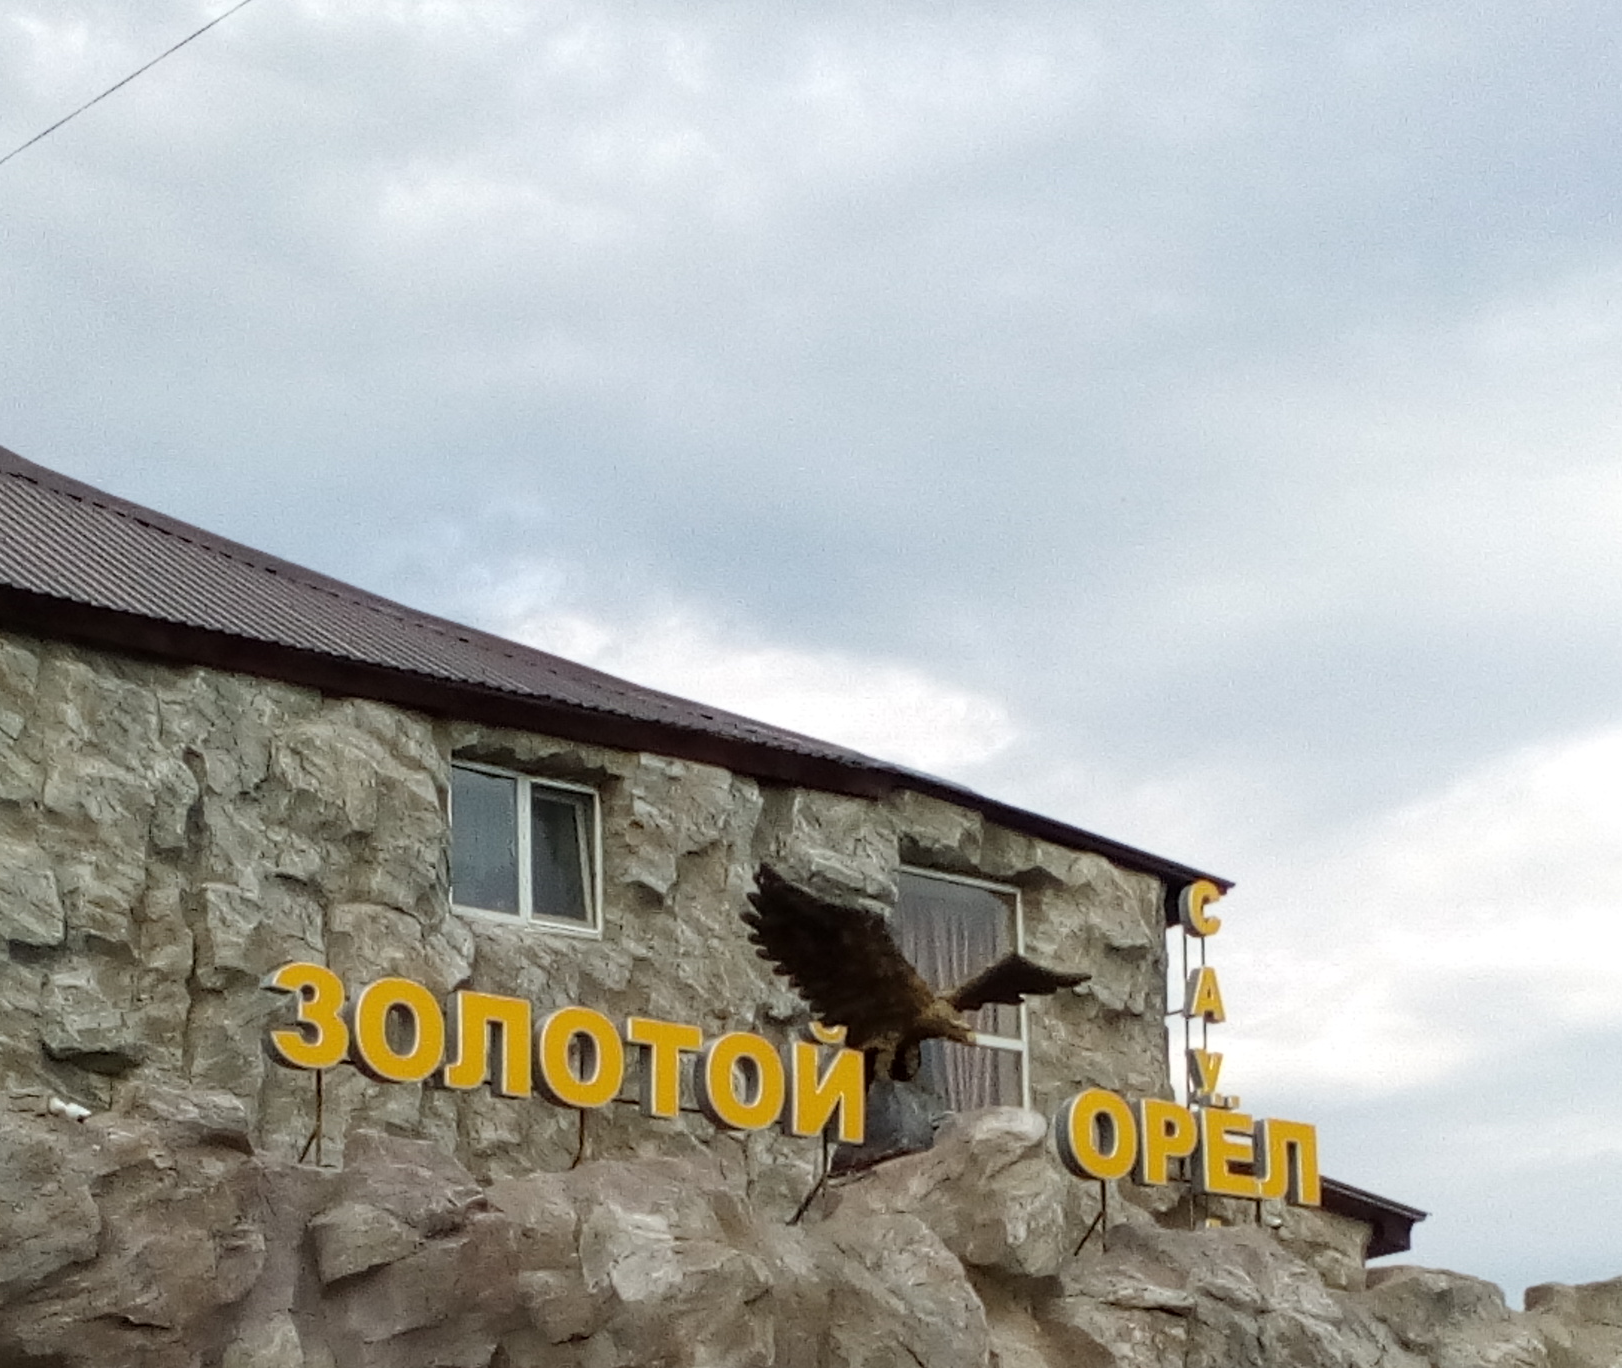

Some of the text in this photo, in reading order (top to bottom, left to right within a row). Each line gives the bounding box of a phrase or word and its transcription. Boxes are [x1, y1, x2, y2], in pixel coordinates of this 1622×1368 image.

[268, 961, 1322, 1207] ЗОЛОТОЙ ОРЁЛ
[1183, 880, 1227, 1098] САУ
